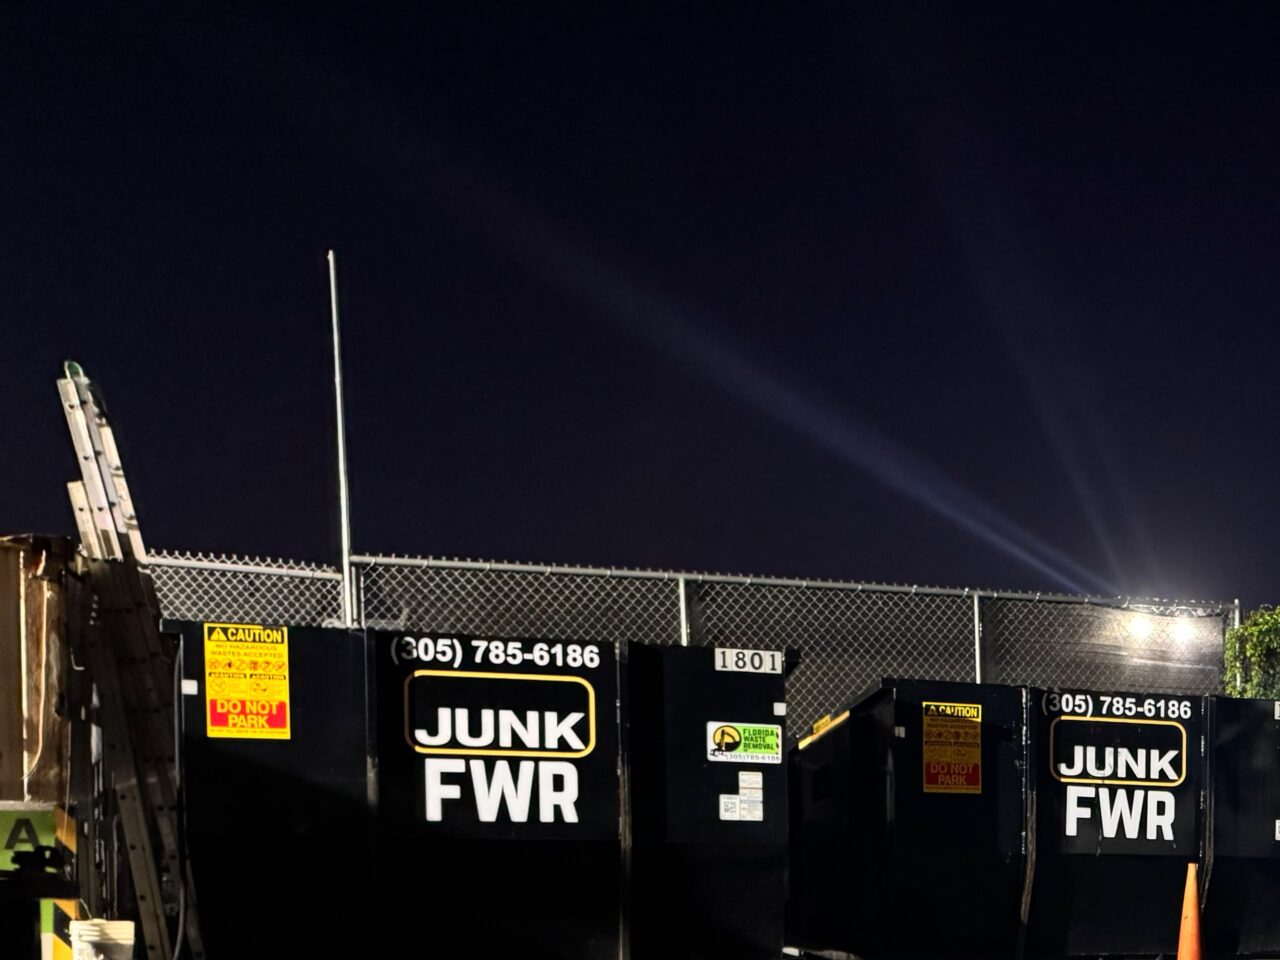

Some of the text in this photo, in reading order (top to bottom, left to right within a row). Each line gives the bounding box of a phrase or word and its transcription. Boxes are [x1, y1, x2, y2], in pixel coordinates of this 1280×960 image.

[227, 628, 282, 643] CAUTION
[391, 636, 600, 668] (305) 785-6186
[721, 650, 777, 671] 1801
[217, 700, 279, 715] DO NOT
[938, 706, 978, 717] CAUTION
[1042, 692, 1192, 719] (305) 785-6186
[228, 714, 269, 728] PARK
[414, 707, 586, 750] JUNK
[742, 728, 775, 736] FLORIDA
[930, 763, 973, 775] DO NOT
[1057, 745, 1180, 780] JUNK
[938, 775, 967, 785] PARK
[425, 758, 579, 823] FWR
[1066, 785, 1176, 841] FWR
